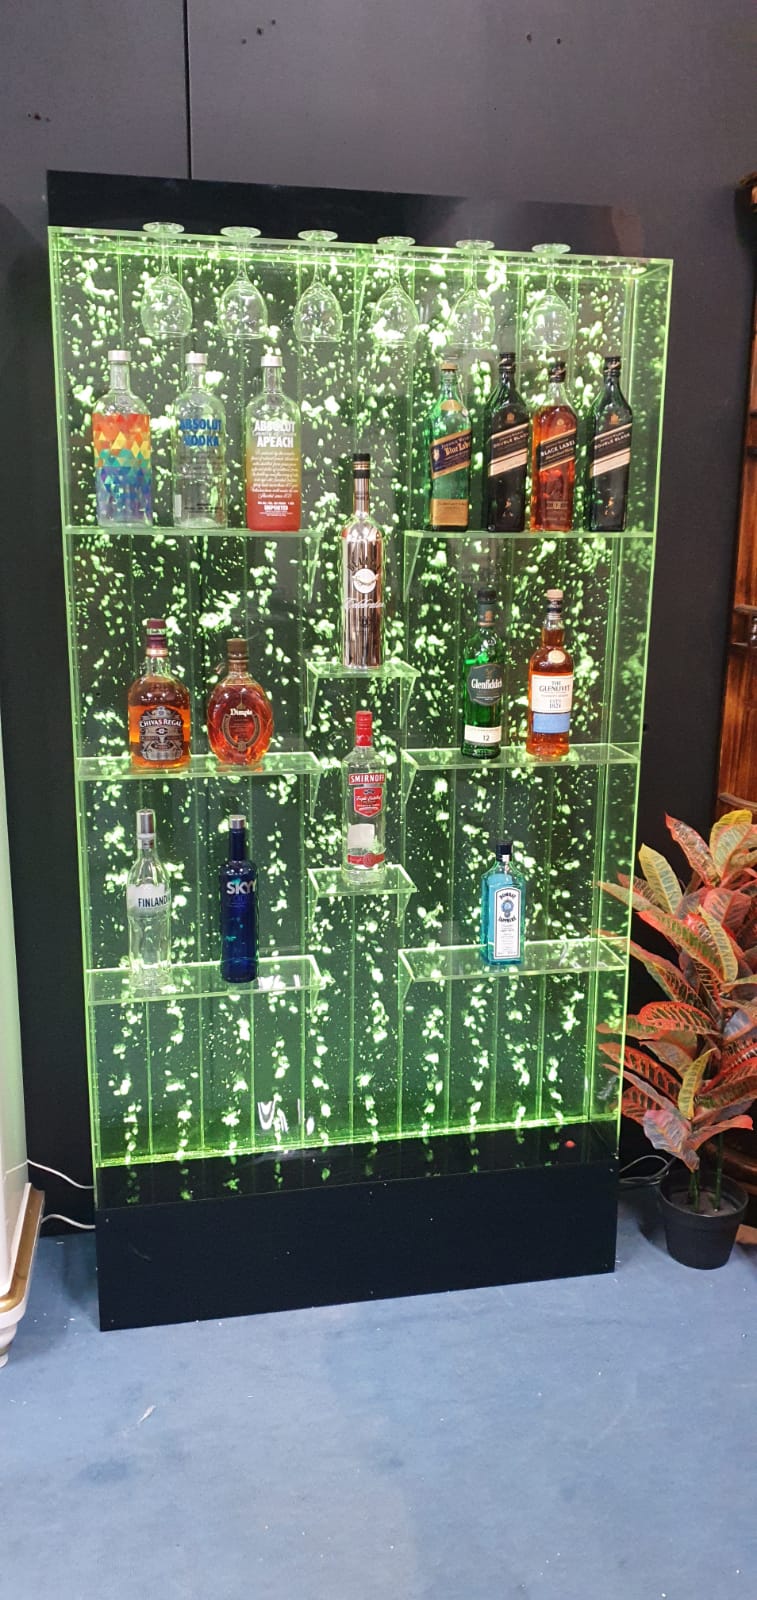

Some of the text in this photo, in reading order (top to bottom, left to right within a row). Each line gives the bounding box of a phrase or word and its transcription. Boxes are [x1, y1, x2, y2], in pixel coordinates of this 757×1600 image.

[179, 419, 221, 431] ABSOLUT
[254, 420, 295, 432] ABSOLUT
[183, 435, 219, 447] VODKA
[256, 437, 294, 448] APEACH
[540, 446, 559, 457] BLACK
[559, 439, 576, 450] LABEL
[230, 708, 253, 717] Dimple
[139, 718, 182, 728] CHIVAS REGAL
[482, 734, 490, 742] 12
[350, 774, 385, 784] SMIRNOFF
[226, 879, 257, 895] SKYY
[137, 895, 168, 908] FINLAND
